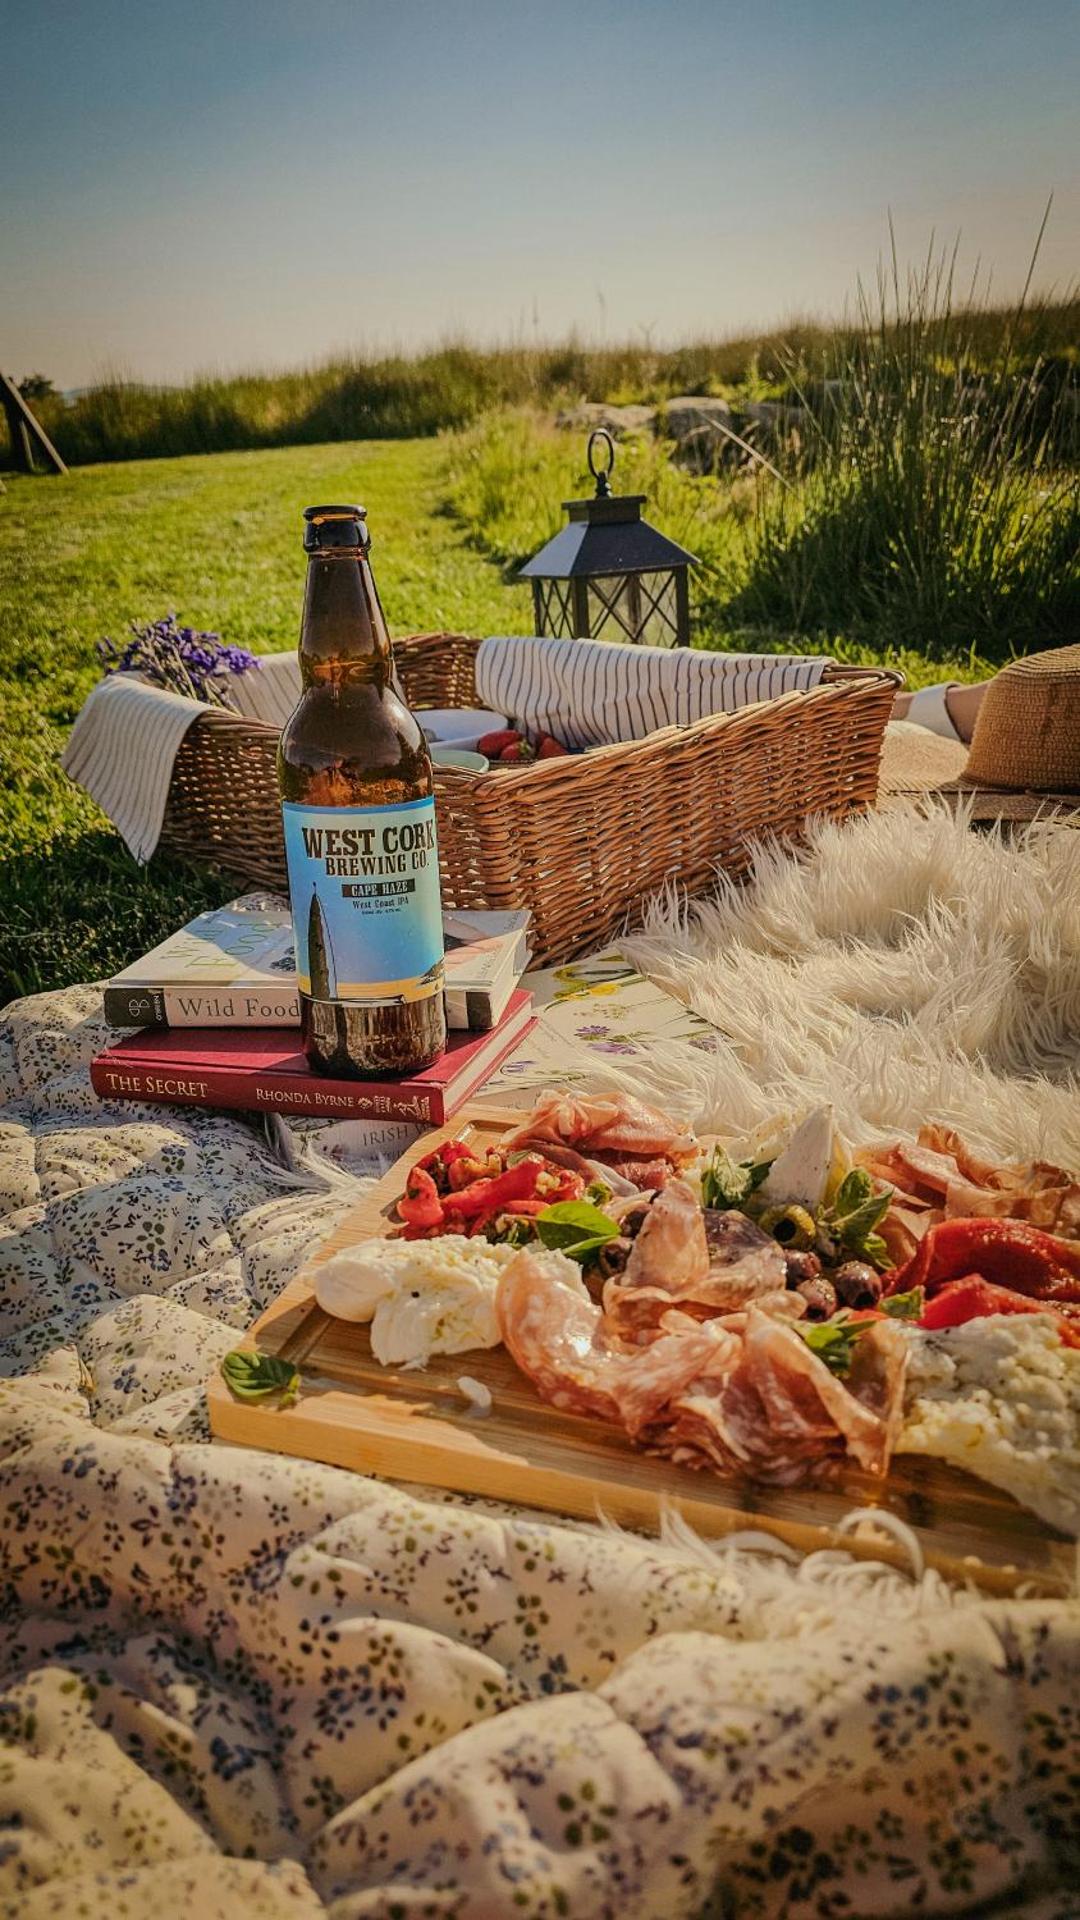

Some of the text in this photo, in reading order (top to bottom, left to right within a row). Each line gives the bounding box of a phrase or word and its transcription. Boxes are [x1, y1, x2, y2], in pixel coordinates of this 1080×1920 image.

[302, 819, 435, 858] WEST CORK
[326, 850, 430, 876] BREWING CO.
[351, 881, 408, 897] CAPE HAZE
[352, 896, 409, 909] West Coast IPA
[178, 997, 300, 1018] Wild Food
[105, 1073, 208, 1098] THE SECRET
[255, 1088, 354, 1107] RHONDA BYRNE
[362, 1124, 408, 1147] IRISH
